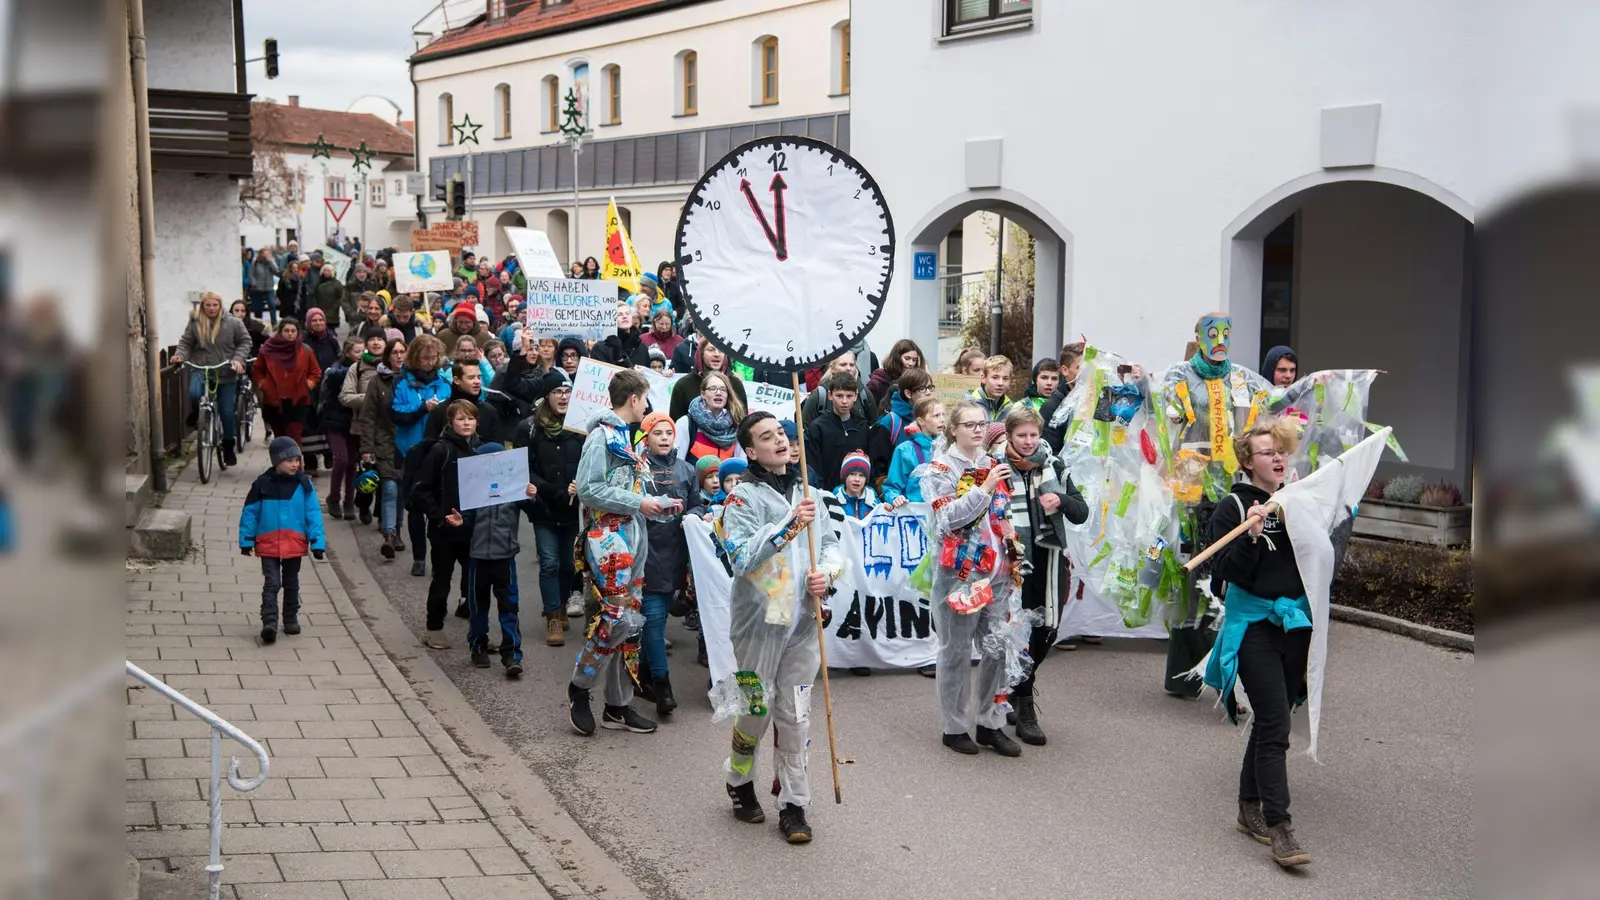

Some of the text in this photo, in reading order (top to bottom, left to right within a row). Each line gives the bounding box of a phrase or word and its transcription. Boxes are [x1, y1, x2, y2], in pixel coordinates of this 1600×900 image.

[767, 152, 788, 172] 12
[736, 167, 747, 177] 11
[827, 165, 834, 176] 1
[853, 189, 861, 199] 2
[705, 200, 721, 211] 10
[695, 250, 702, 261] 9
[868, 245, 876, 255] 3
[919, 256, 931, 264] WC
[529, 280, 589, 293] WAS HABEN
[858, 286, 864, 295] 4
[528, 292, 602, 307] KLIMALEUGNER
[554, 309, 617, 322] GEMEINSAM?
[713, 304, 720, 316] 8
[836, 319, 844, 330] 5
[742, 328, 752, 340] 7
[786, 340, 794, 352] 6
[583, 363, 603, 377] SAY
[592, 380, 606, 392] TO
[756, 386, 795, 401] BEHIN
[1210, 382, 1225, 454] SPARPACK
